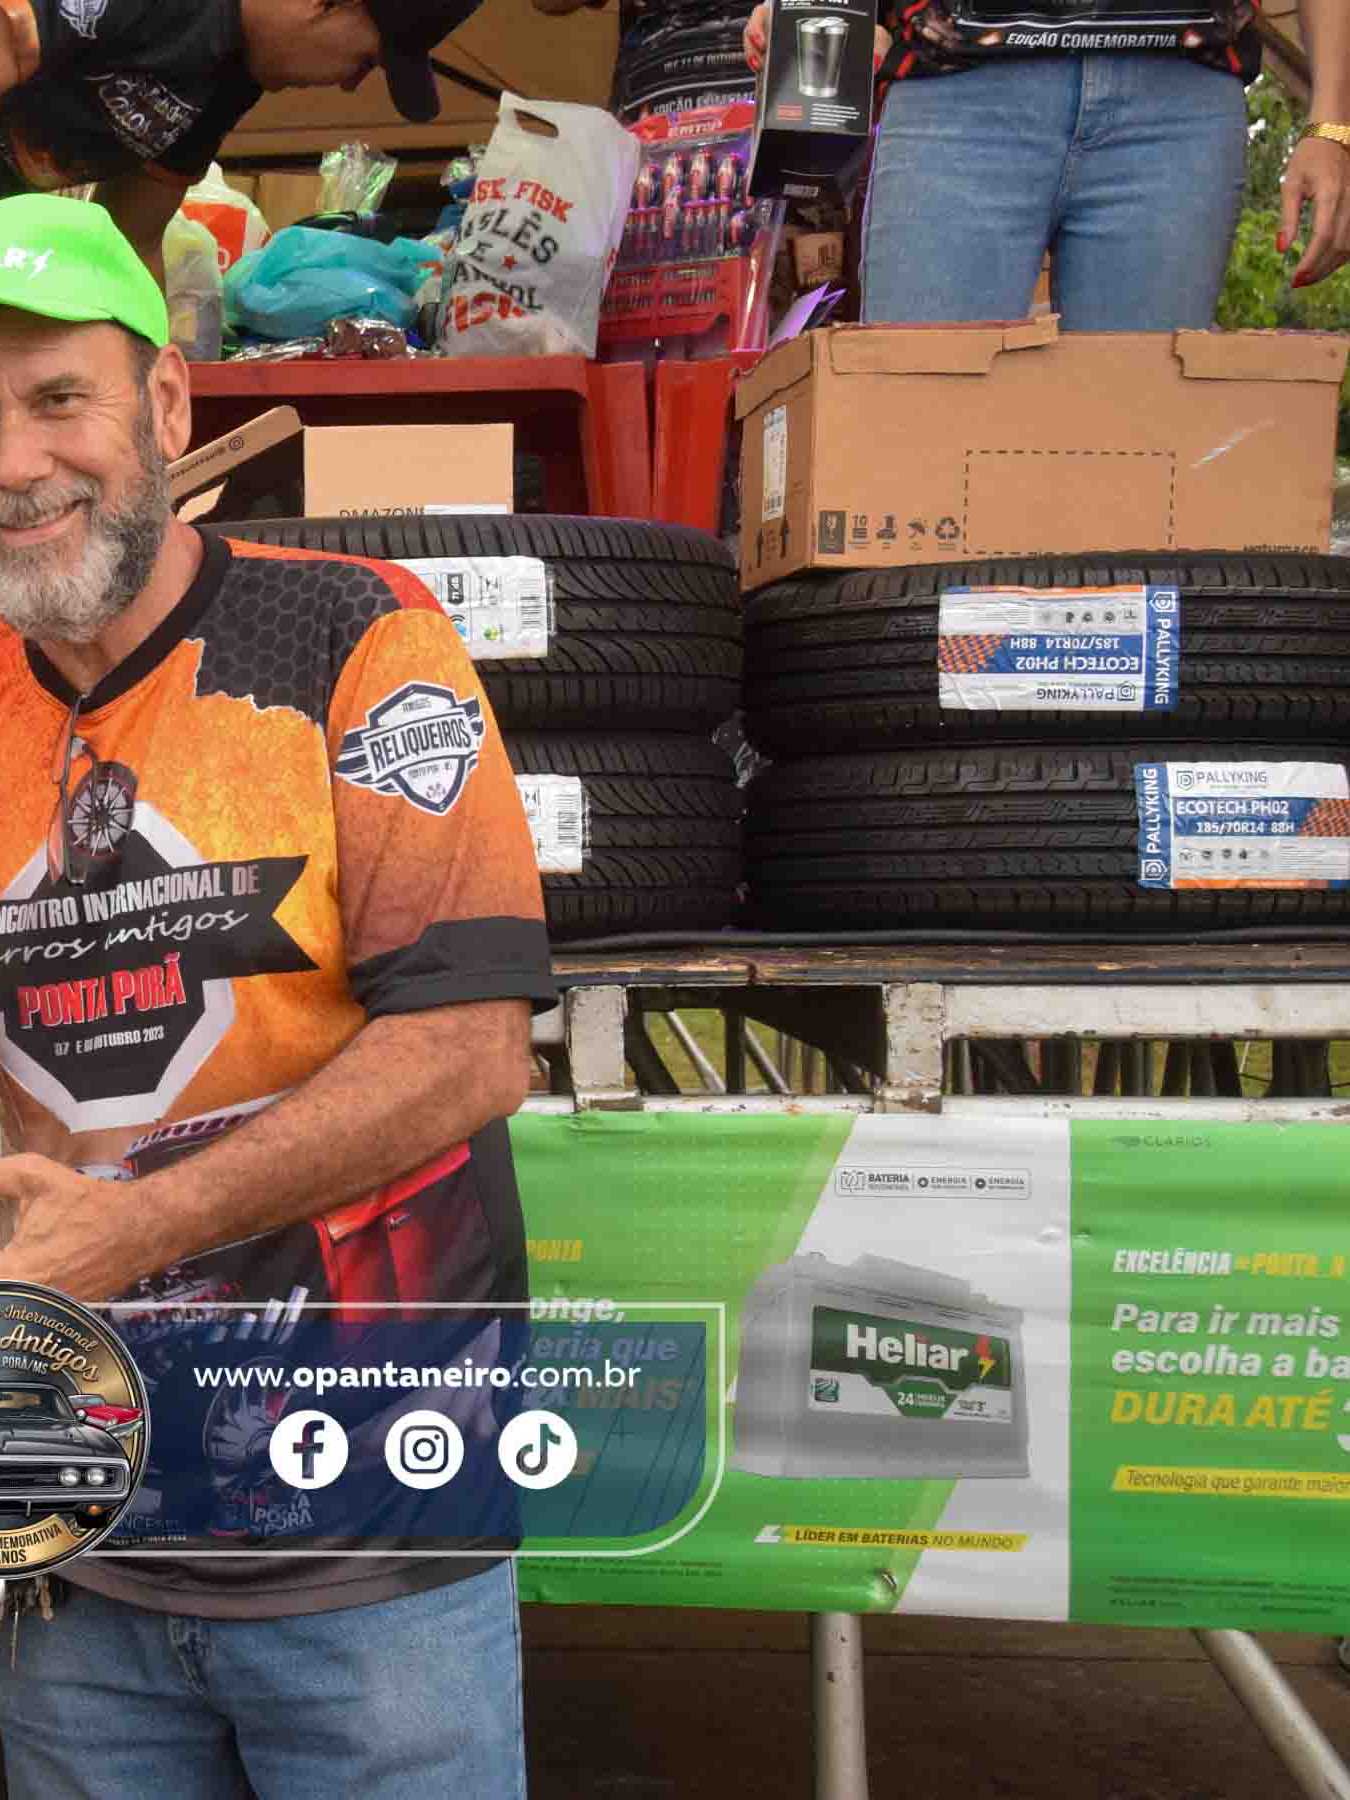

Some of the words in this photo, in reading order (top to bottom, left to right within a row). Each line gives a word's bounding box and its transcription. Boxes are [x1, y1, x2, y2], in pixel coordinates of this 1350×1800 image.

[1006, 31, 1057, 48] EDIÇÃO
[1061, 33, 1178, 49] COMEMORATIVA
[513, 180, 573, 224] FISK
[1010, 637, 1037, 649] 88H
[1045, 637, 1121, 650] 185/70R14
[1015, 656, 1060, 671] PH02
[1063, 656, 1140, 672] ECOTECH
[1154, 618, 1171, 705] PALLYKING
[1036, 687, 1115, 700] PALLYKING
[369, 718, 472, 774] RELIQUEIROS
[1196, 770, 1268, 784] PALLYKING
[1145, 767, 1161, 854] PALLYKING
[1176, 800, 1247, 816] ECOTECH
[1249, 800, 1290, 815] PH02
[1196, 821, 1265, 835] 185/70R14
[1271, 821, 1295, 833] 88H
[231, 864, 261, 896] DE
[17, 974, 109, 1030] PONTA
[111, 951, 187, 1016] PORÃ
[143, 1025, 165, 1043] 2023
[868, 1173, 910, 1184] BATERIA
[1112, 1247, 1232, 1276] EXCELÊNCIA
[529, 1296, 626, 1323] onge,
[1111, 1303, 1200, 1335] Para
[1207, 1304, 1241, 1336] ir
[1246, 1305, 1341, 1339] mais
[847, 1323, 970, 1371] Heliar
[1111, 1344, 1264, 1377] escolha
[1270, 1352, 1296, 1377] a
[898, 1392, 915, 1406] 24
[1110, 1391, 1236, 1426] DURA
[1245, 1386, 1336, 1431] ATÉ
[1128, 1469, 1208, 1491] Tecnologia
[1211, 1475, 1242, 1493] que
[1244, 1476, 1301, 1494] garante
[795, 1528, 835, 1543] LÍDER
[838, 1531, 859, 1543] EM
[861, 1532, 930, 1546] BATERIAS
[931, 1534, 954, 1547] NO
[958, 1535, 1014, 1550] MUNDO
